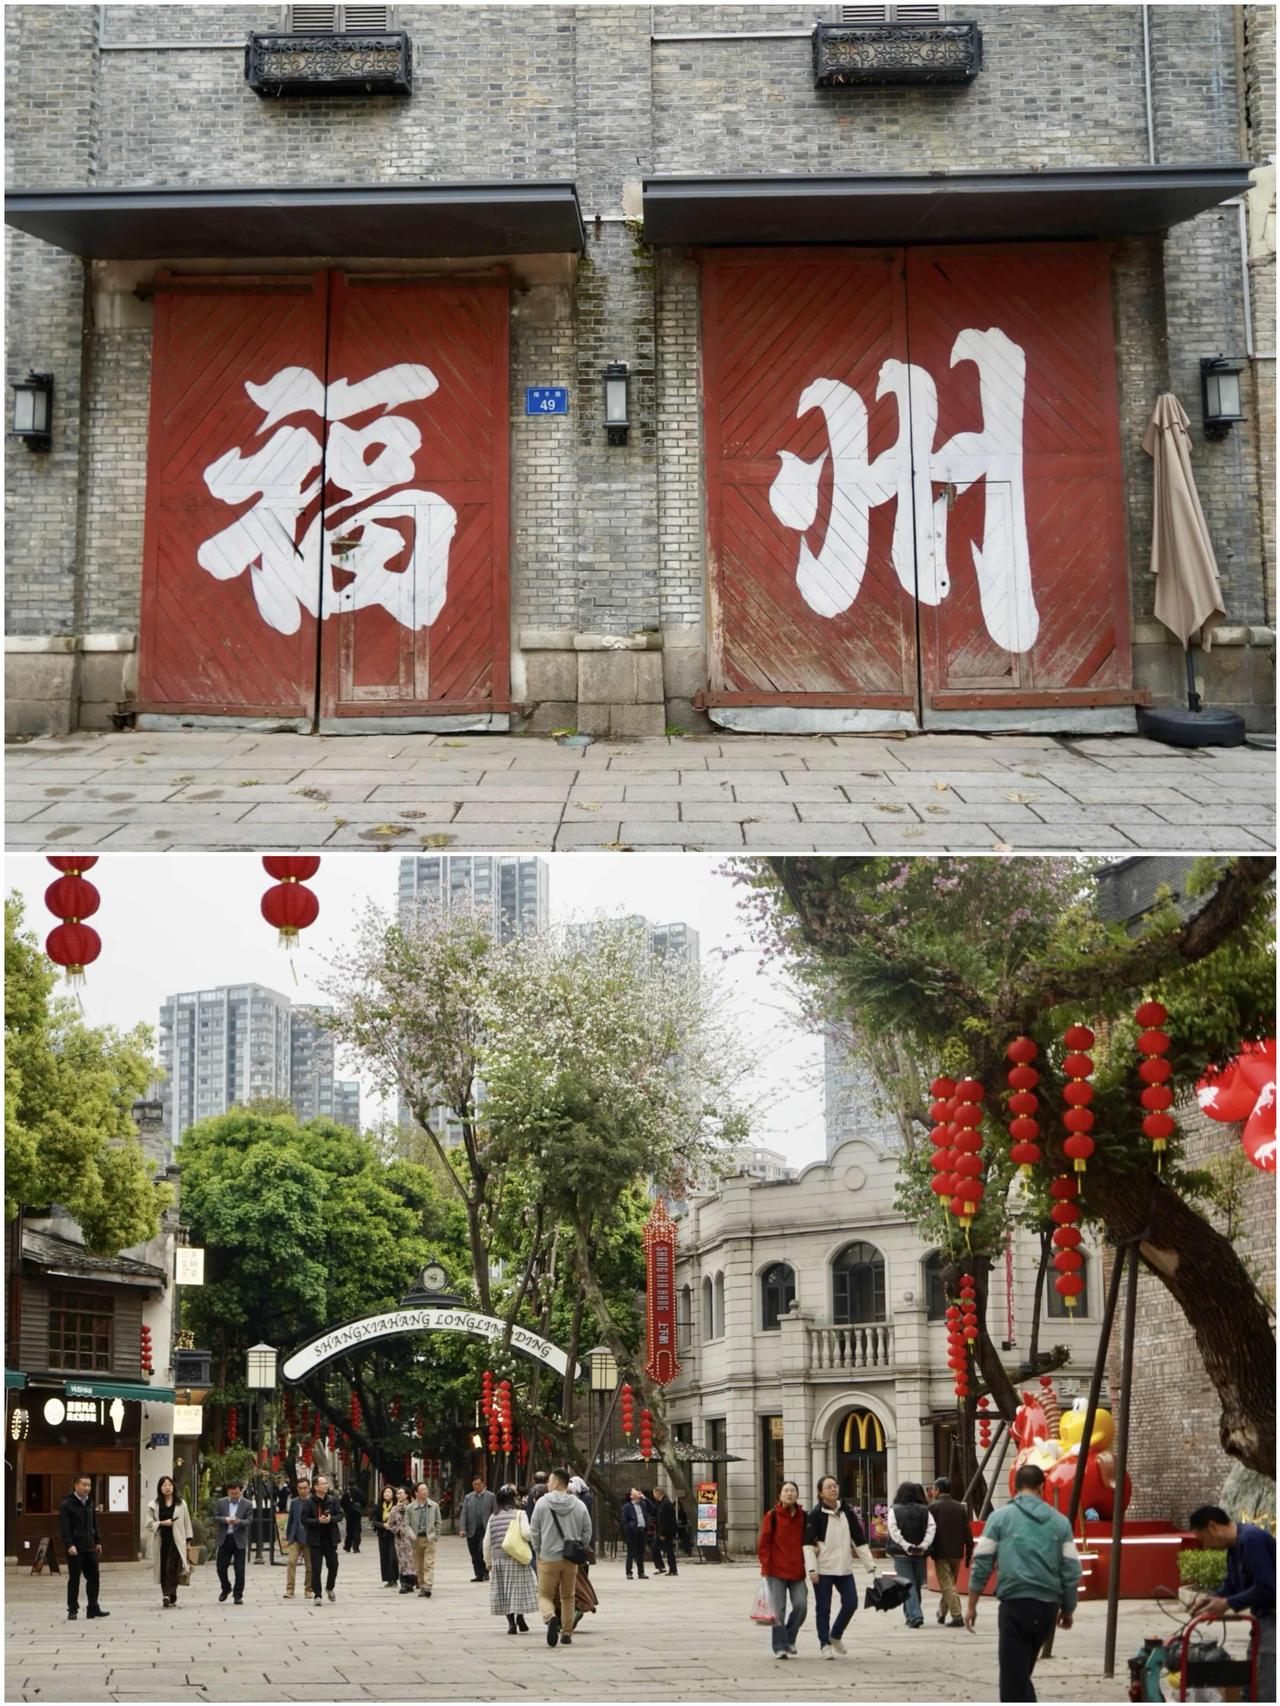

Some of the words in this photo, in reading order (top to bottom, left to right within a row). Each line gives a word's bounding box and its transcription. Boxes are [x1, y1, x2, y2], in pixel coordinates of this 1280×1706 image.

[540, 399, 556, 411] 49
[197, 363, 458, 635] 福
[769, 327, 1040, 653] 州
[314, 1310, 431, 1358] SHANGXIAHANG
